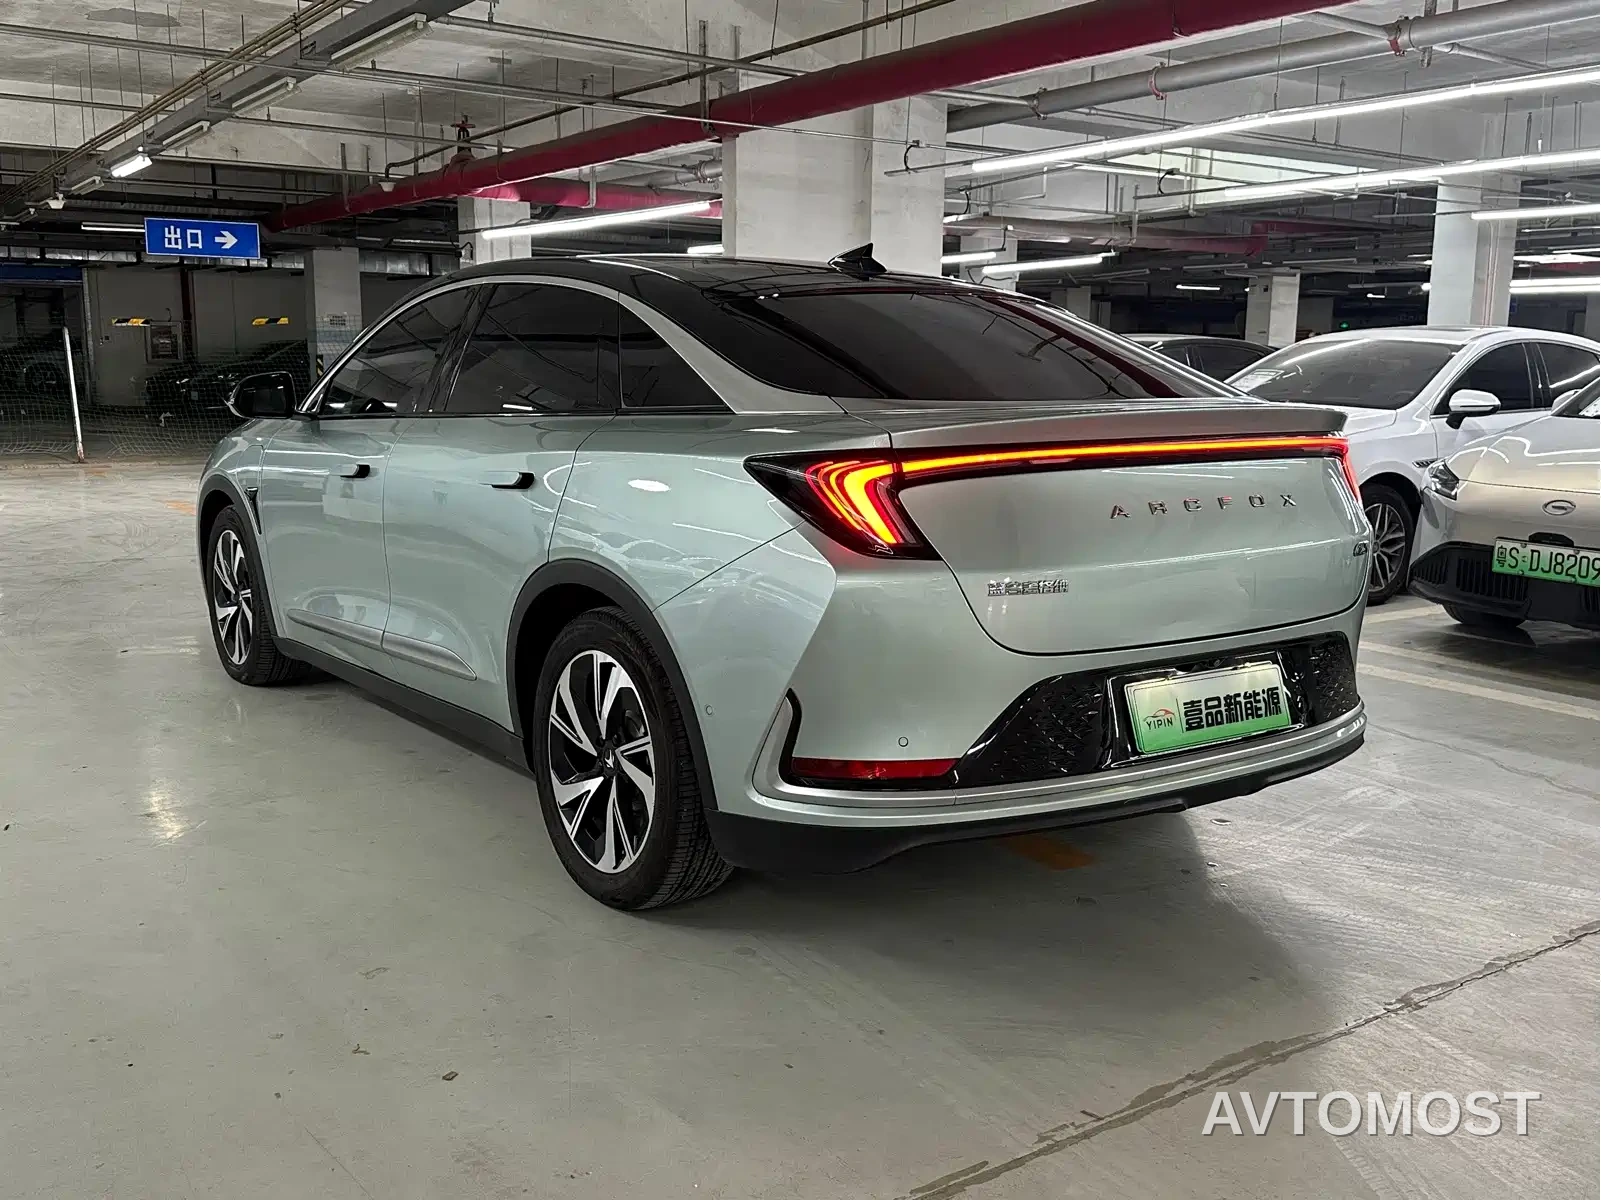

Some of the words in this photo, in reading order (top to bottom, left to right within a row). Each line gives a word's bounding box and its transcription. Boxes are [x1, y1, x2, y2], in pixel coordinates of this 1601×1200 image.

[164, 225, 203, 250] 出口
[1110, 494, 1297, 520] ARCFOX
[1145, 717, 1174, 731] YIPIN
[1183, 686, 1283, 732] 壹品新能源
